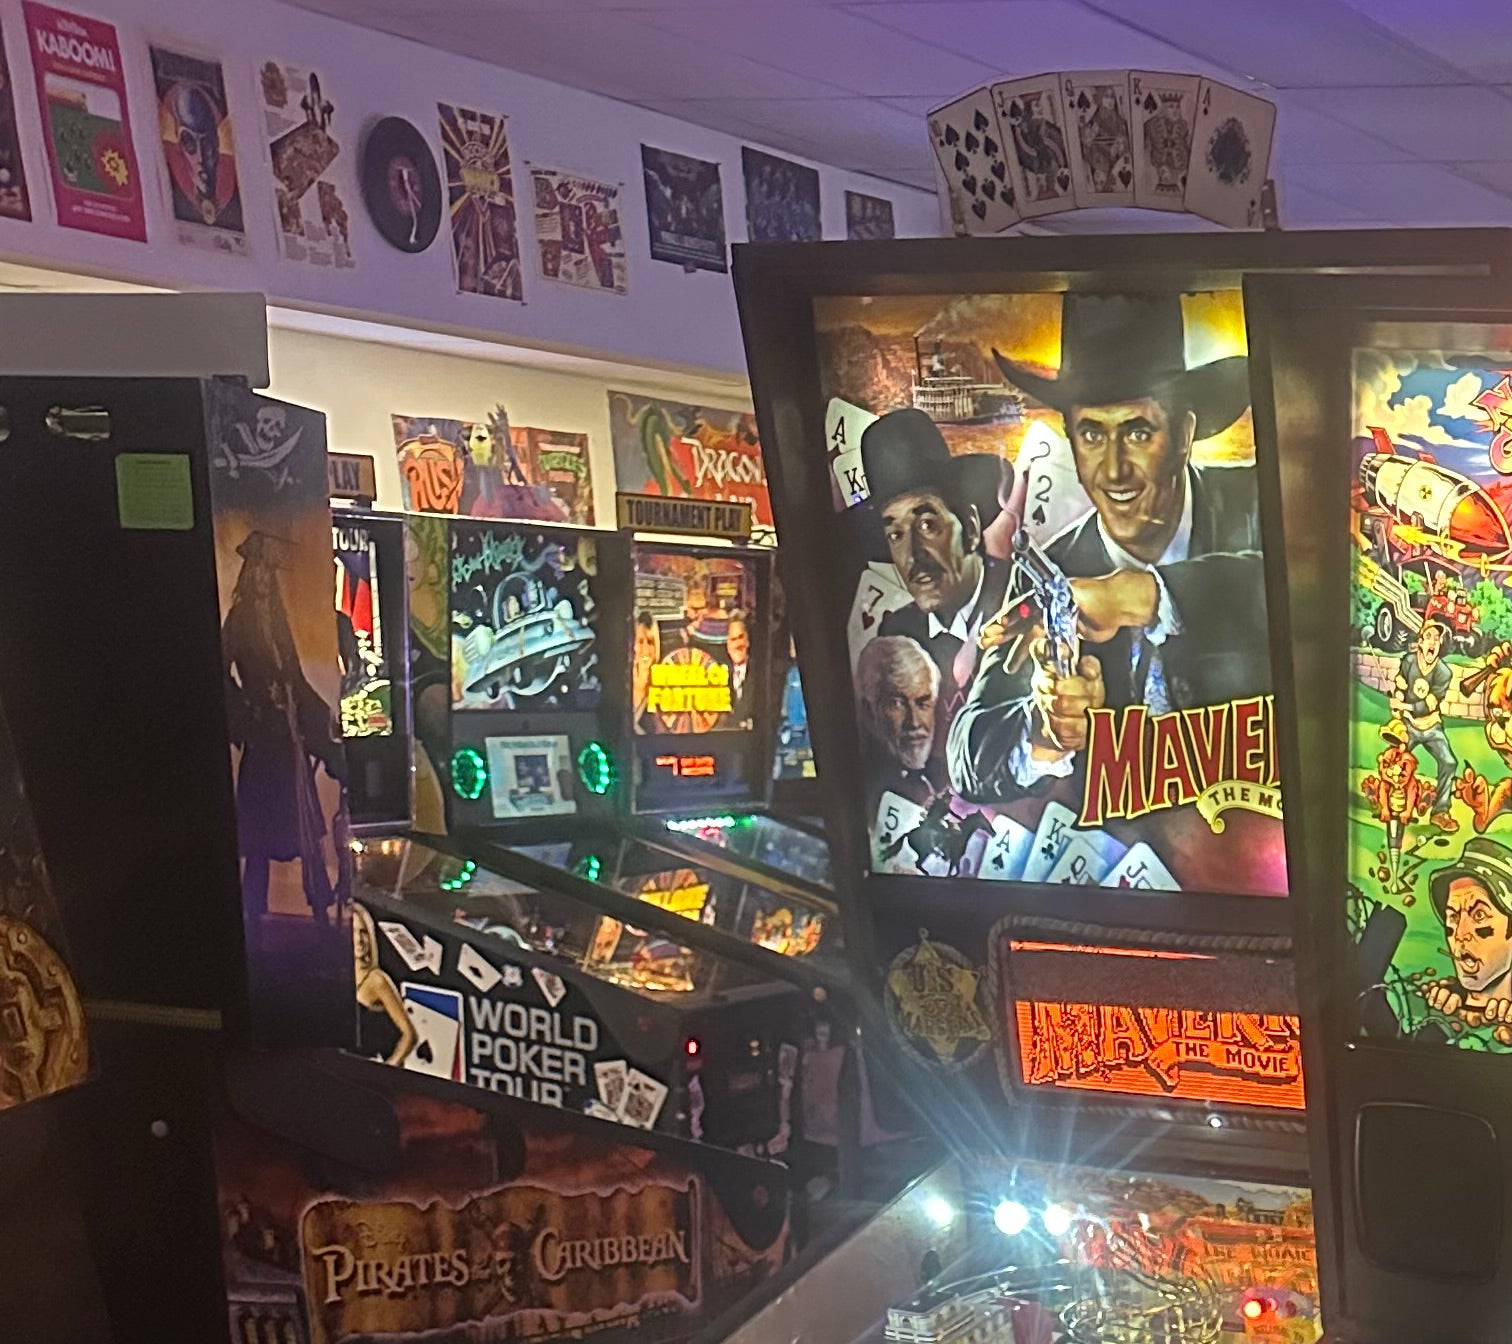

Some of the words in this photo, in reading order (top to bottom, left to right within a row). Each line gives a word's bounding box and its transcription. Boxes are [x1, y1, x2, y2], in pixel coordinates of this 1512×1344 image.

[36, 29, 116, 72] KABOOM!
[1133, 78, 1143, 96] K
[832, 417, 846, 445] A
[844, 468, 863, 494] K
[1036, 474, 1052, 502] 2
[627, 498, 712, 531] TOURNAMENT
[714, 506, 743, 533] PLAY
[1078, 694, 1281, 826] MAVE
[1209, 785, 1251, 807] THE
[884, 806, 899, 831] 5
[1047, 817, 1065, 843] K
[996, 829, 1011, 854] A
[1070, 854, 1087, 878] Q
[469, 996, 598, 1051] WORLD
[471, 1032, 587, 1086] POKER
[1172, 1041, 1209, 1057] THE
[1225, 1049, 1290, 1073] MOVIE
[312, 1245, 470, 1304] PIRATES
[533, 1227, 690, 1282] CARIBBEAN
